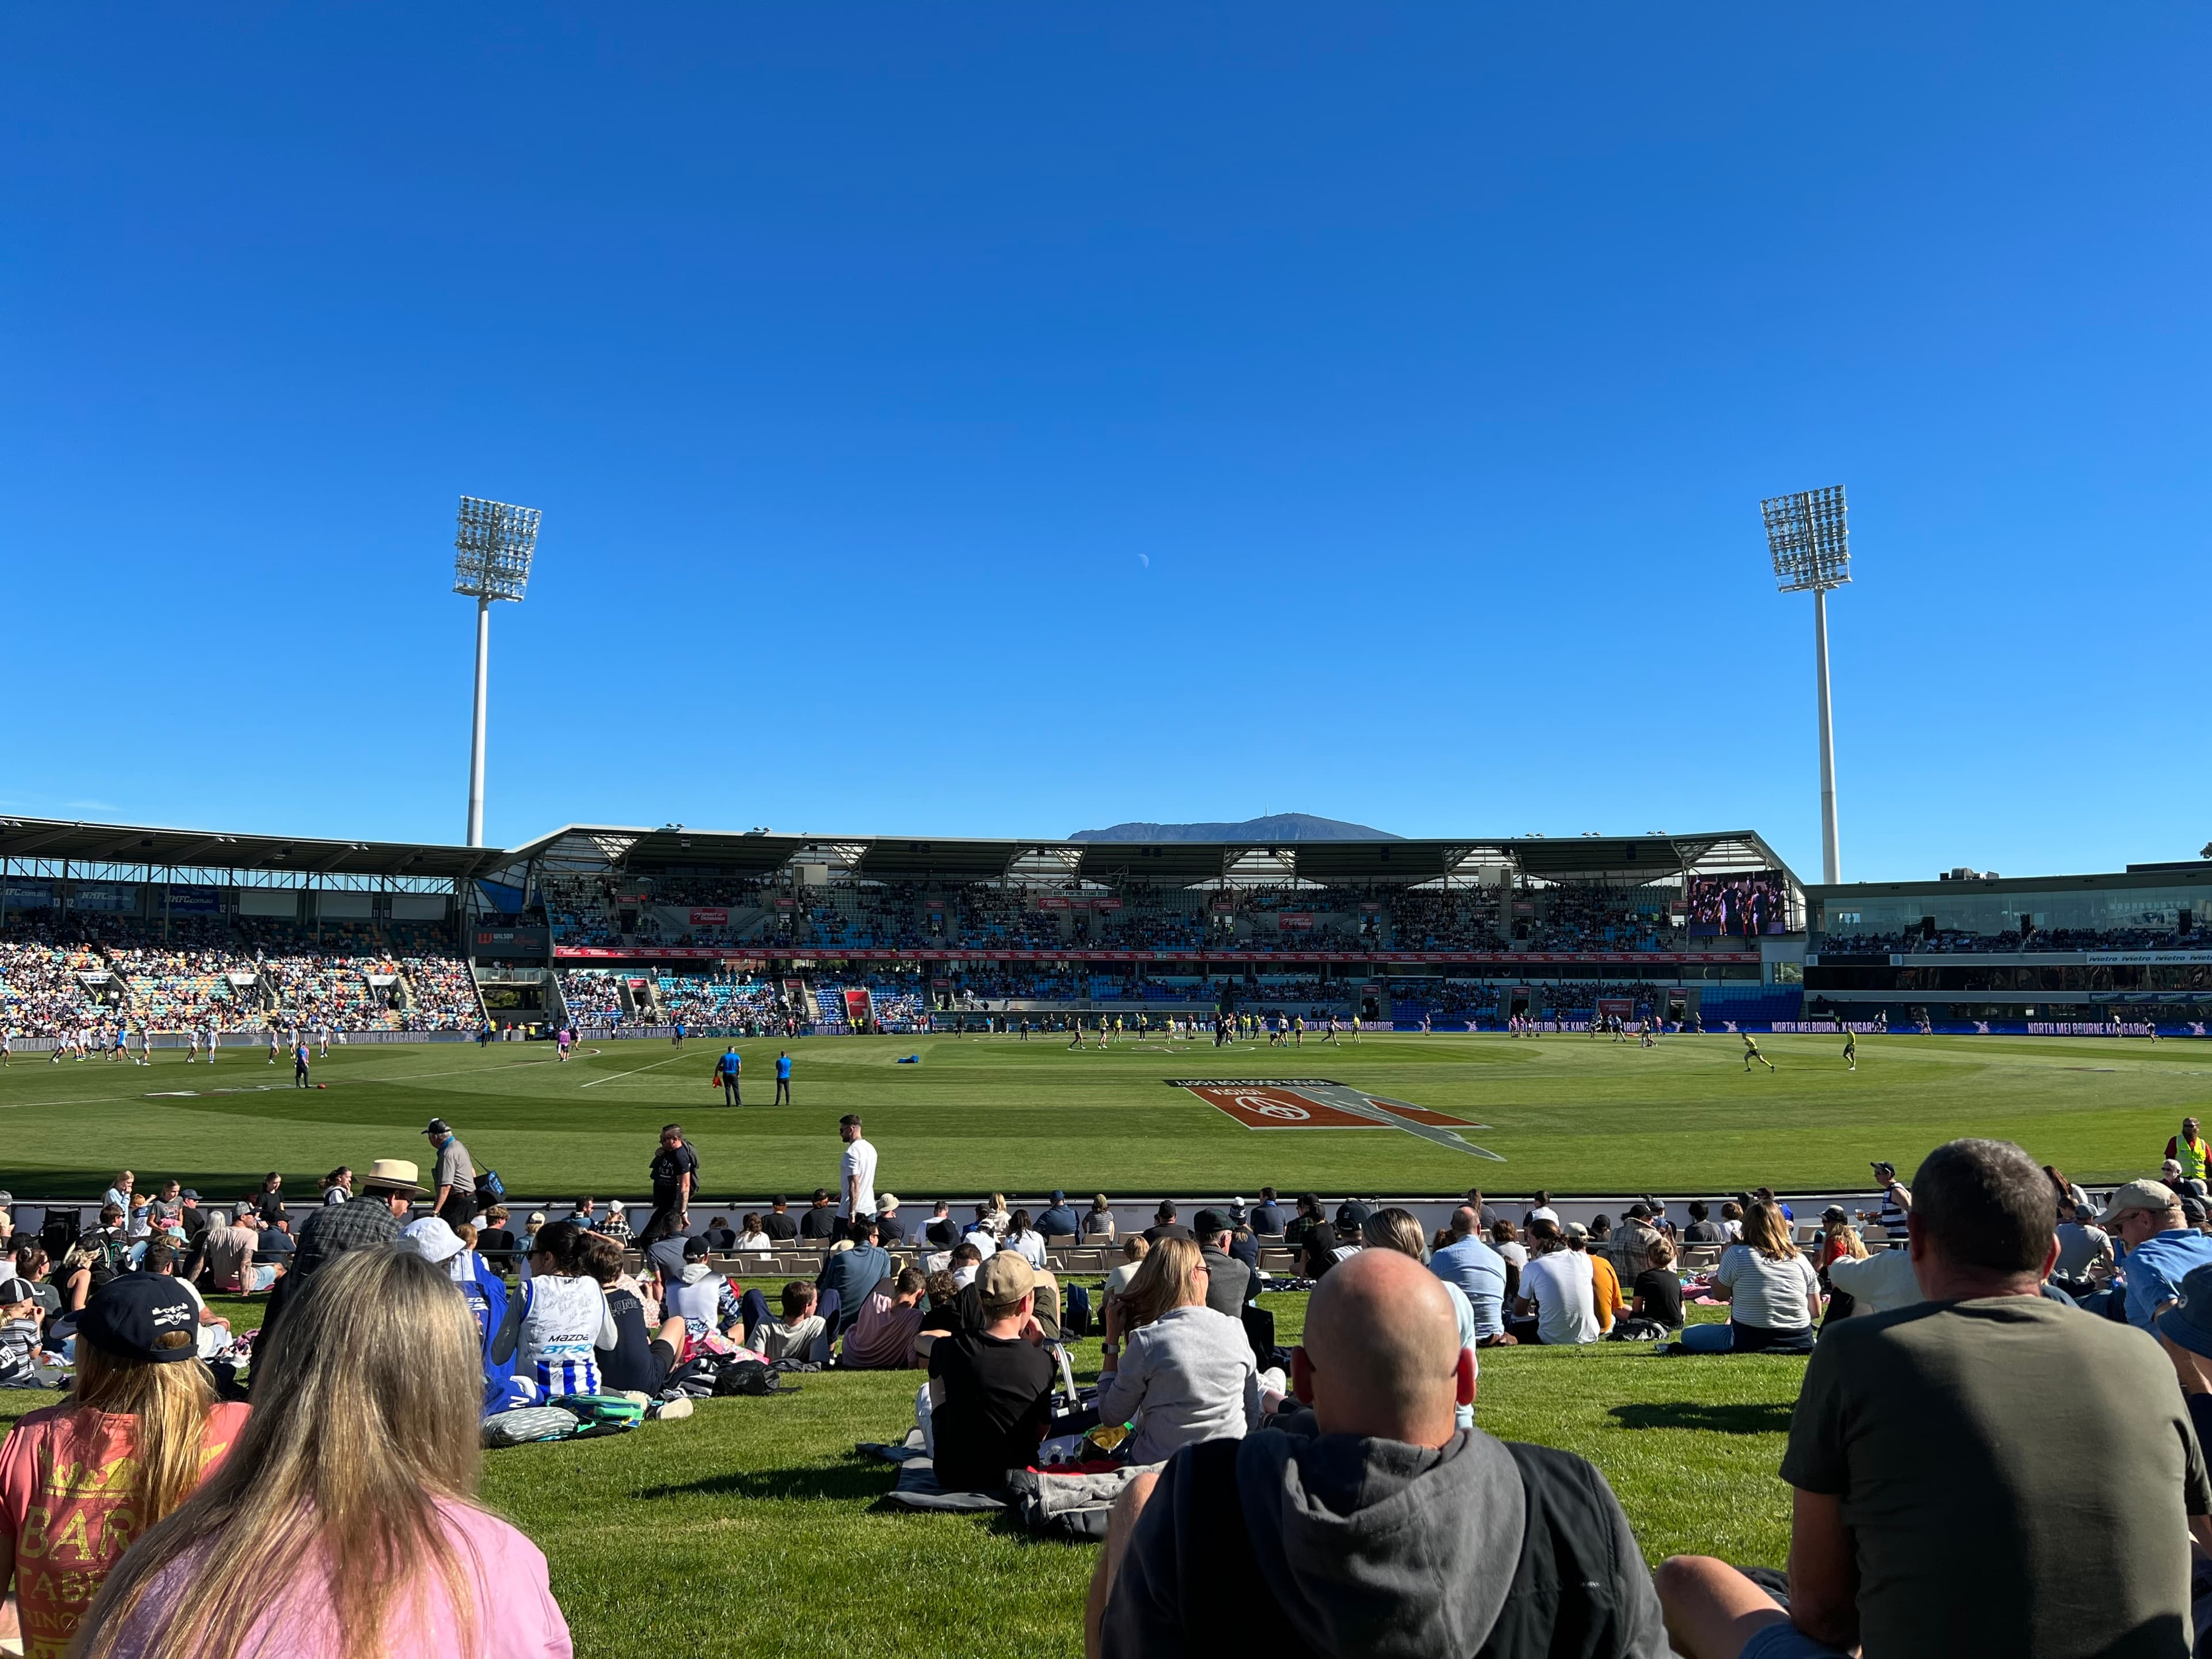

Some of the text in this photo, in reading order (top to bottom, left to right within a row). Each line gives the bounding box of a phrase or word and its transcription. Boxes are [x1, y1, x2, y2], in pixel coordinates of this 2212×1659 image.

[53, 897, 60, 907] 13
[66, 899, 74, 908] 12
[219, 904, 226, 913] 12
[232, 904, 238, 914] 11
[815, 1025, 839, 1035] NORTH
[1302, 1021, 1318, 1031] ORTH
[1359, 1021, 1393, 1031] ANGAROOS
[1532, 1022, 1570, 1032] MELBOUNE
[1772, 1022, 1796, 1032] NORTH
[2028, 1022, 2054, 1033] NORTH
[383, 1032, 429, 1043] KANGAROOS
[581, 1029, 602, 1040] ORTH
[12, 1038, 36, 1051] ORTH
[541, 1343, 593, 1355] BT-50
